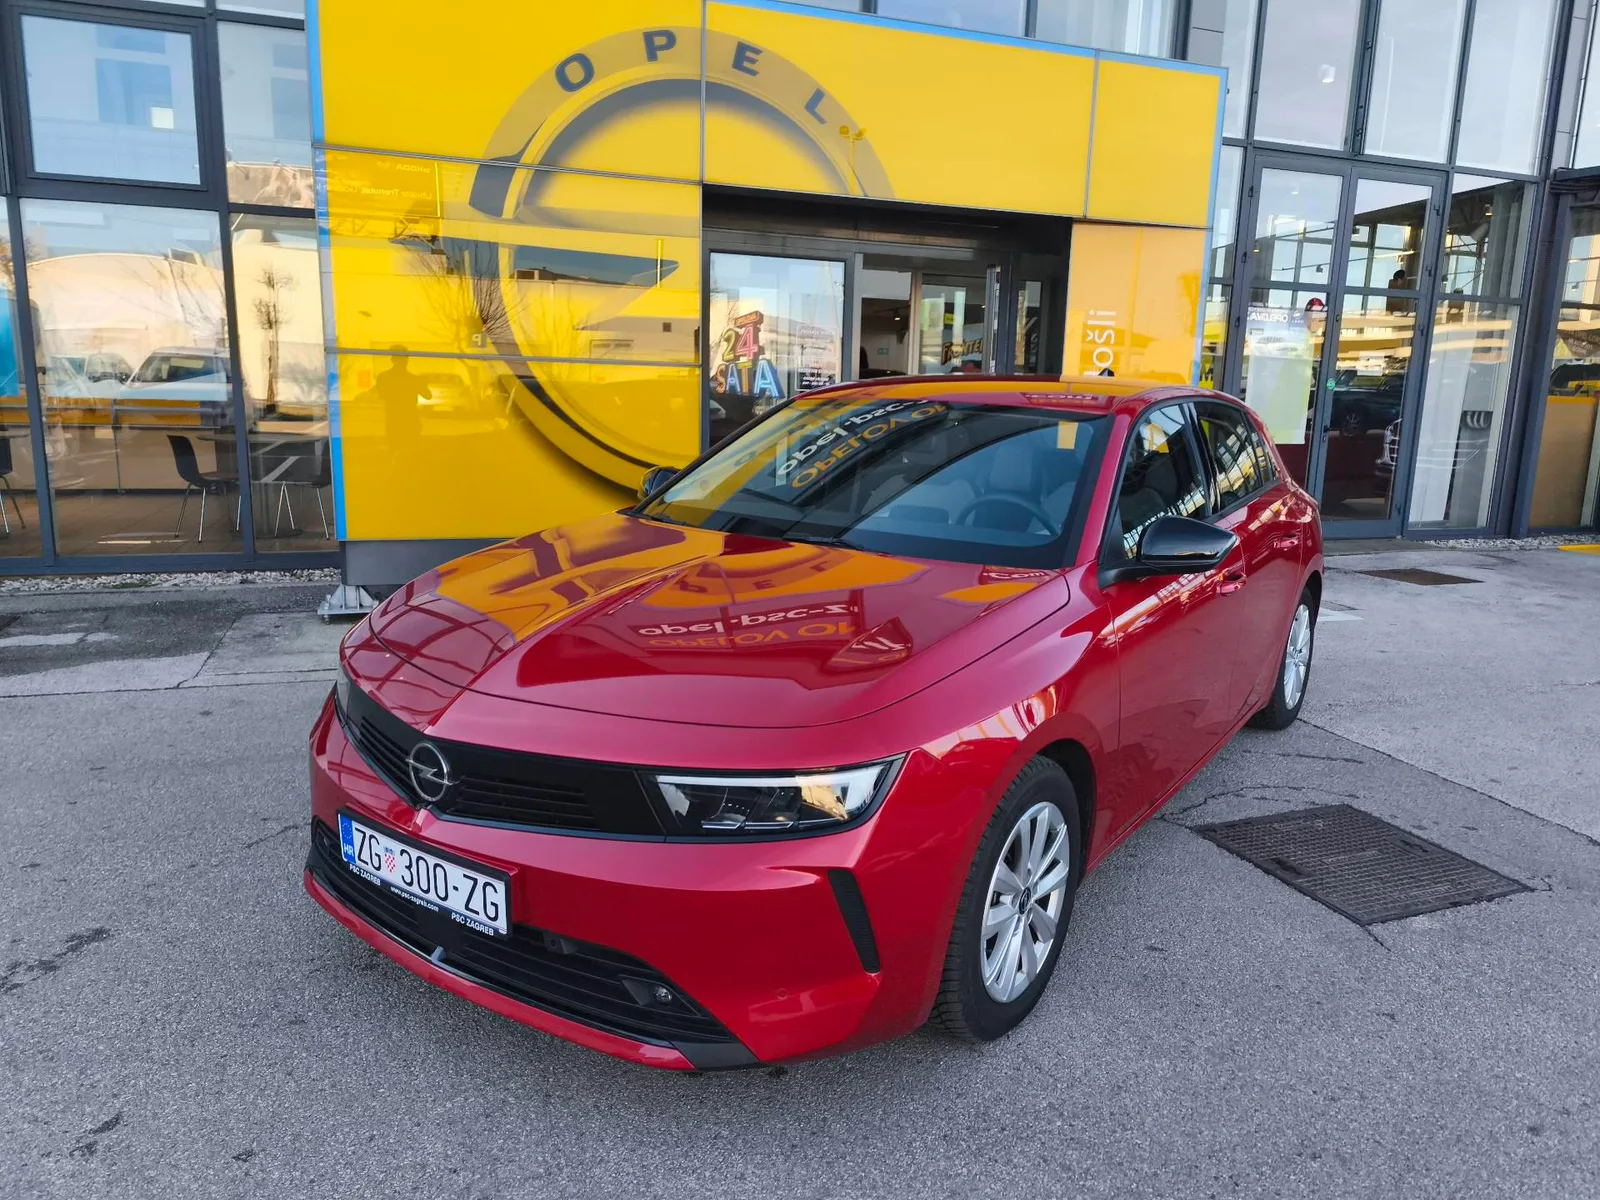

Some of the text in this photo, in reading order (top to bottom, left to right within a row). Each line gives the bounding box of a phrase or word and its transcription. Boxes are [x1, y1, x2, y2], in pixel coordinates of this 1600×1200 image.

[554, 29, 828, 125] OPEL
[721, 325, 760, 362] 24
[715, 359, 783, 400] SATA
[343, 843, 354, 857] HR
[354, 827, 499, 922] ZG 300-ZG
[451, 912, 494, 937] PSC ZAGREB
